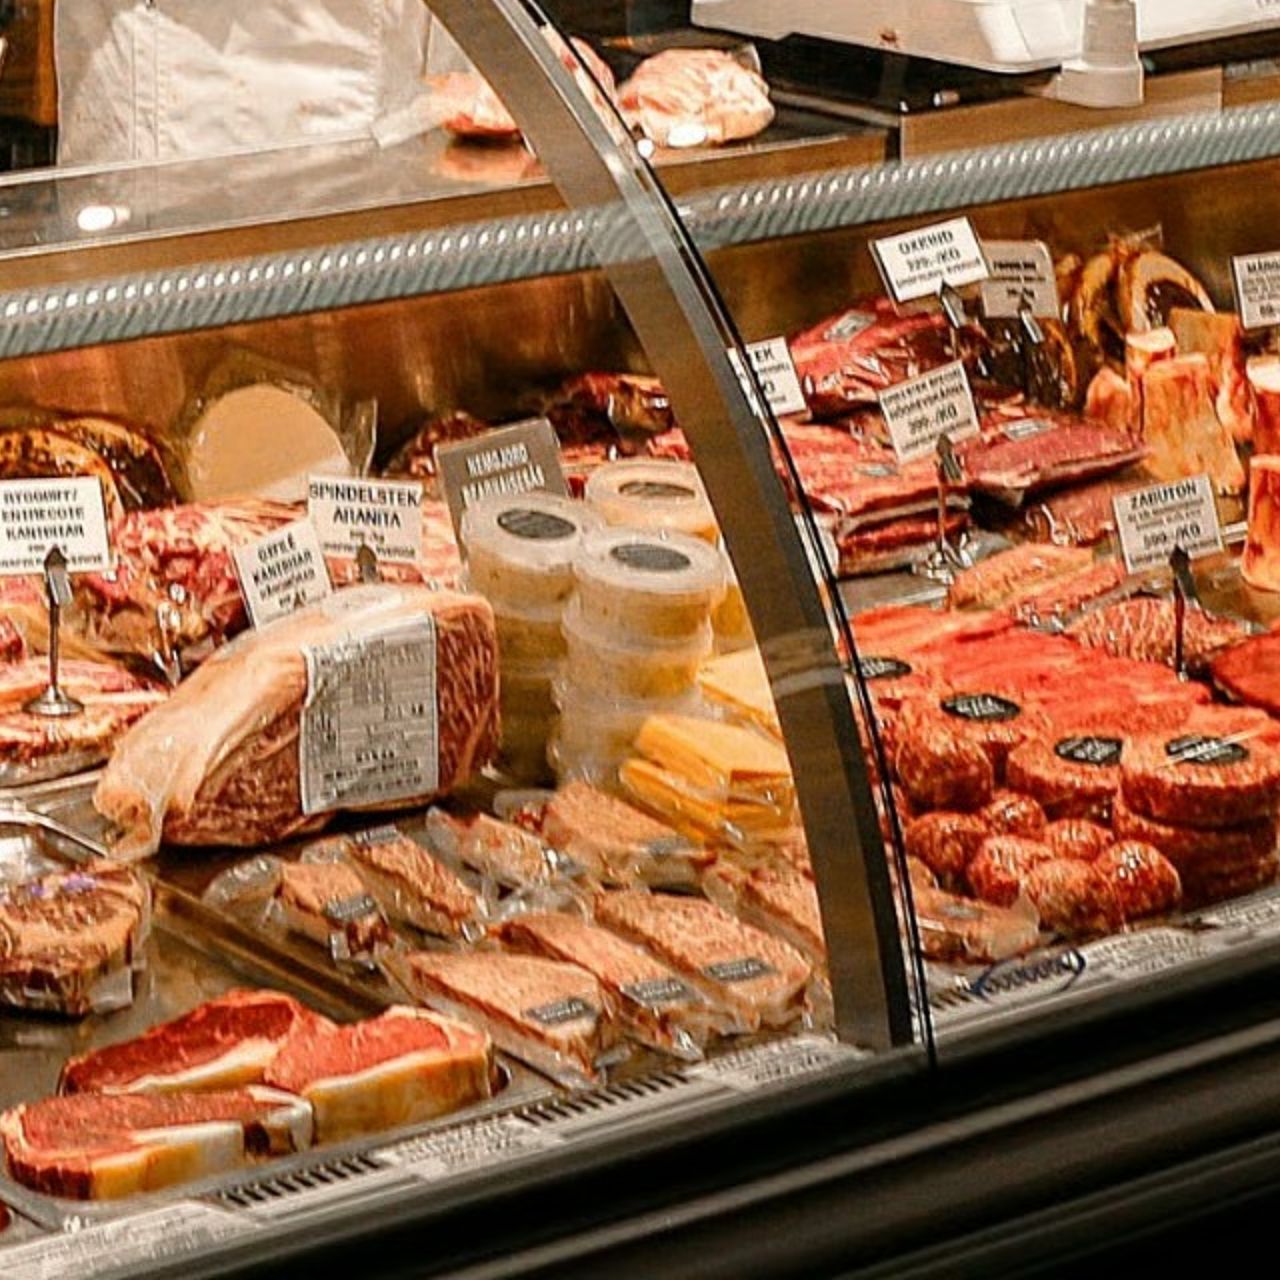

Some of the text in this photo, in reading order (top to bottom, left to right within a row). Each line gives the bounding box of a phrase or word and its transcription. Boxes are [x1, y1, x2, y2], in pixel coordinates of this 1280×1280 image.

[309, 481, 420, 508] SPINDELSTEK
[1130, 480, 1197, 510] ZABUTON
[1, 506, 85, 522] ENTRECOTE
